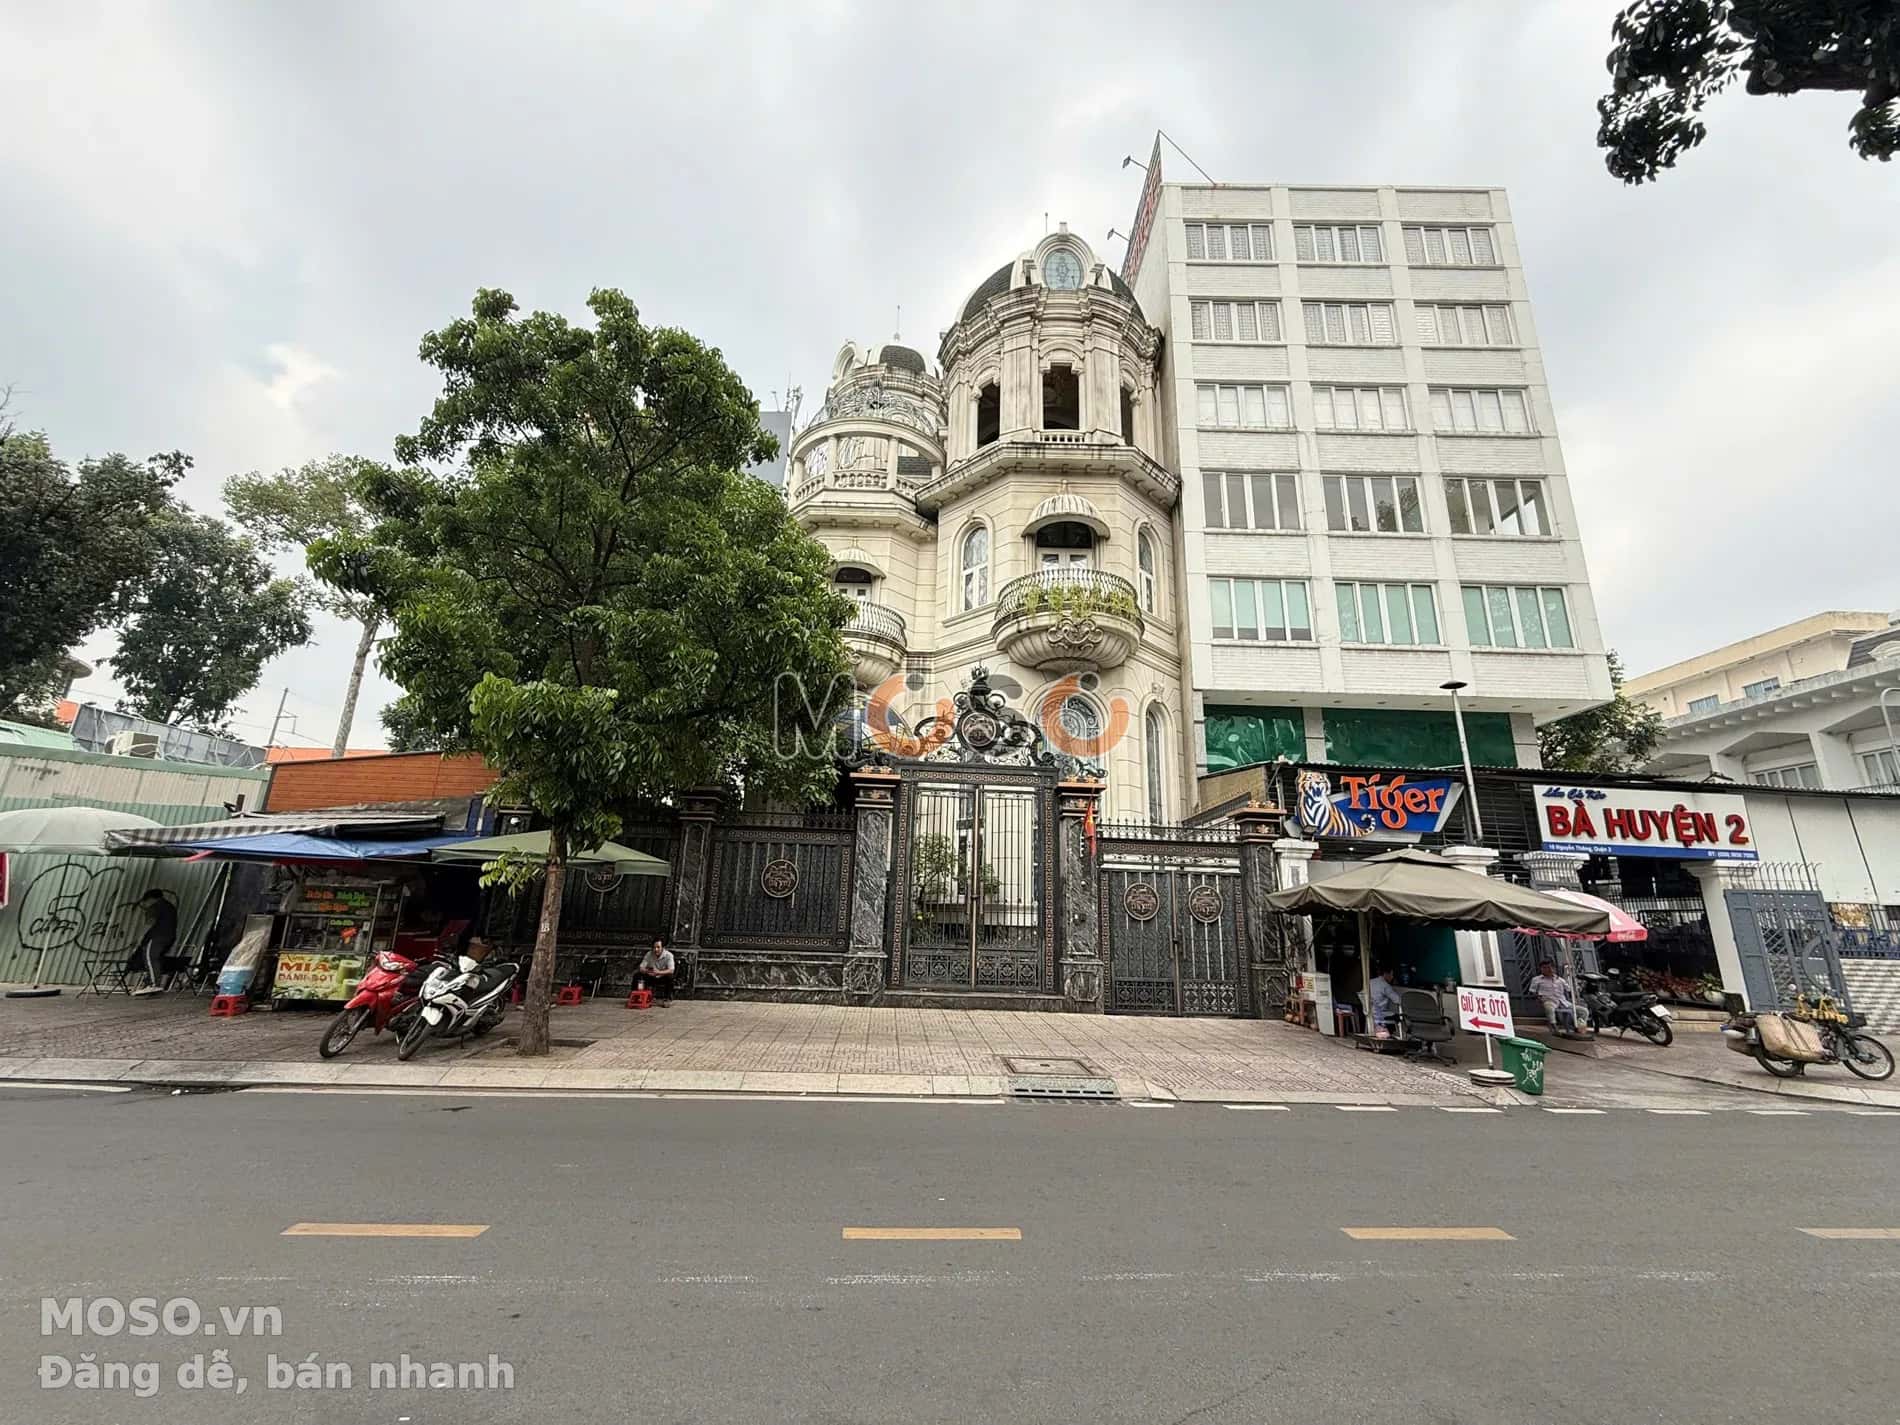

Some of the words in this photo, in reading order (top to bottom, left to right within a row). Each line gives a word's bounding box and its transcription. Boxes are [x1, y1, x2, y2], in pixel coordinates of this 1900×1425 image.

[1340, 774, 1444, 829] Tiger
[1545, 800, 1597, 840] BÀ
[1603, 804, 1719, 847] HUYỆN
[1725, 814, 1749, 844] 2
[1476, 997, 1487, 1014] XE
